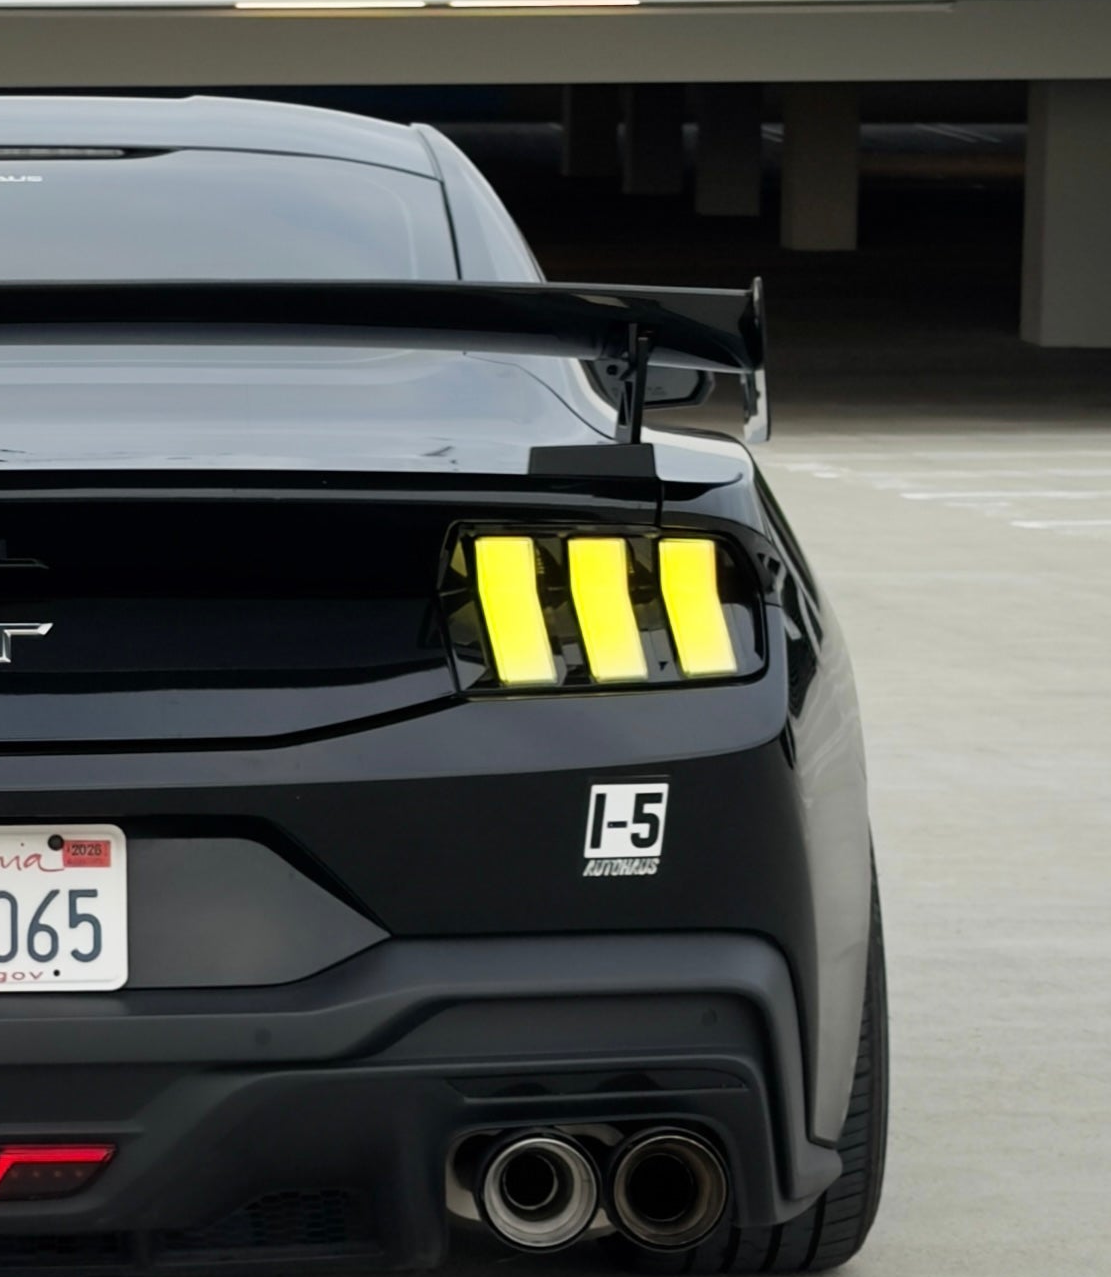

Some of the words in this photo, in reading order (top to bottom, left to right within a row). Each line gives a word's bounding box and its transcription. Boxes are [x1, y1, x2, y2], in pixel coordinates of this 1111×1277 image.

[590, 792, 663, 849] I-5
[71, 843, 102, 856] 2026
[582, 858, 660, 877] AUTOHAUS
